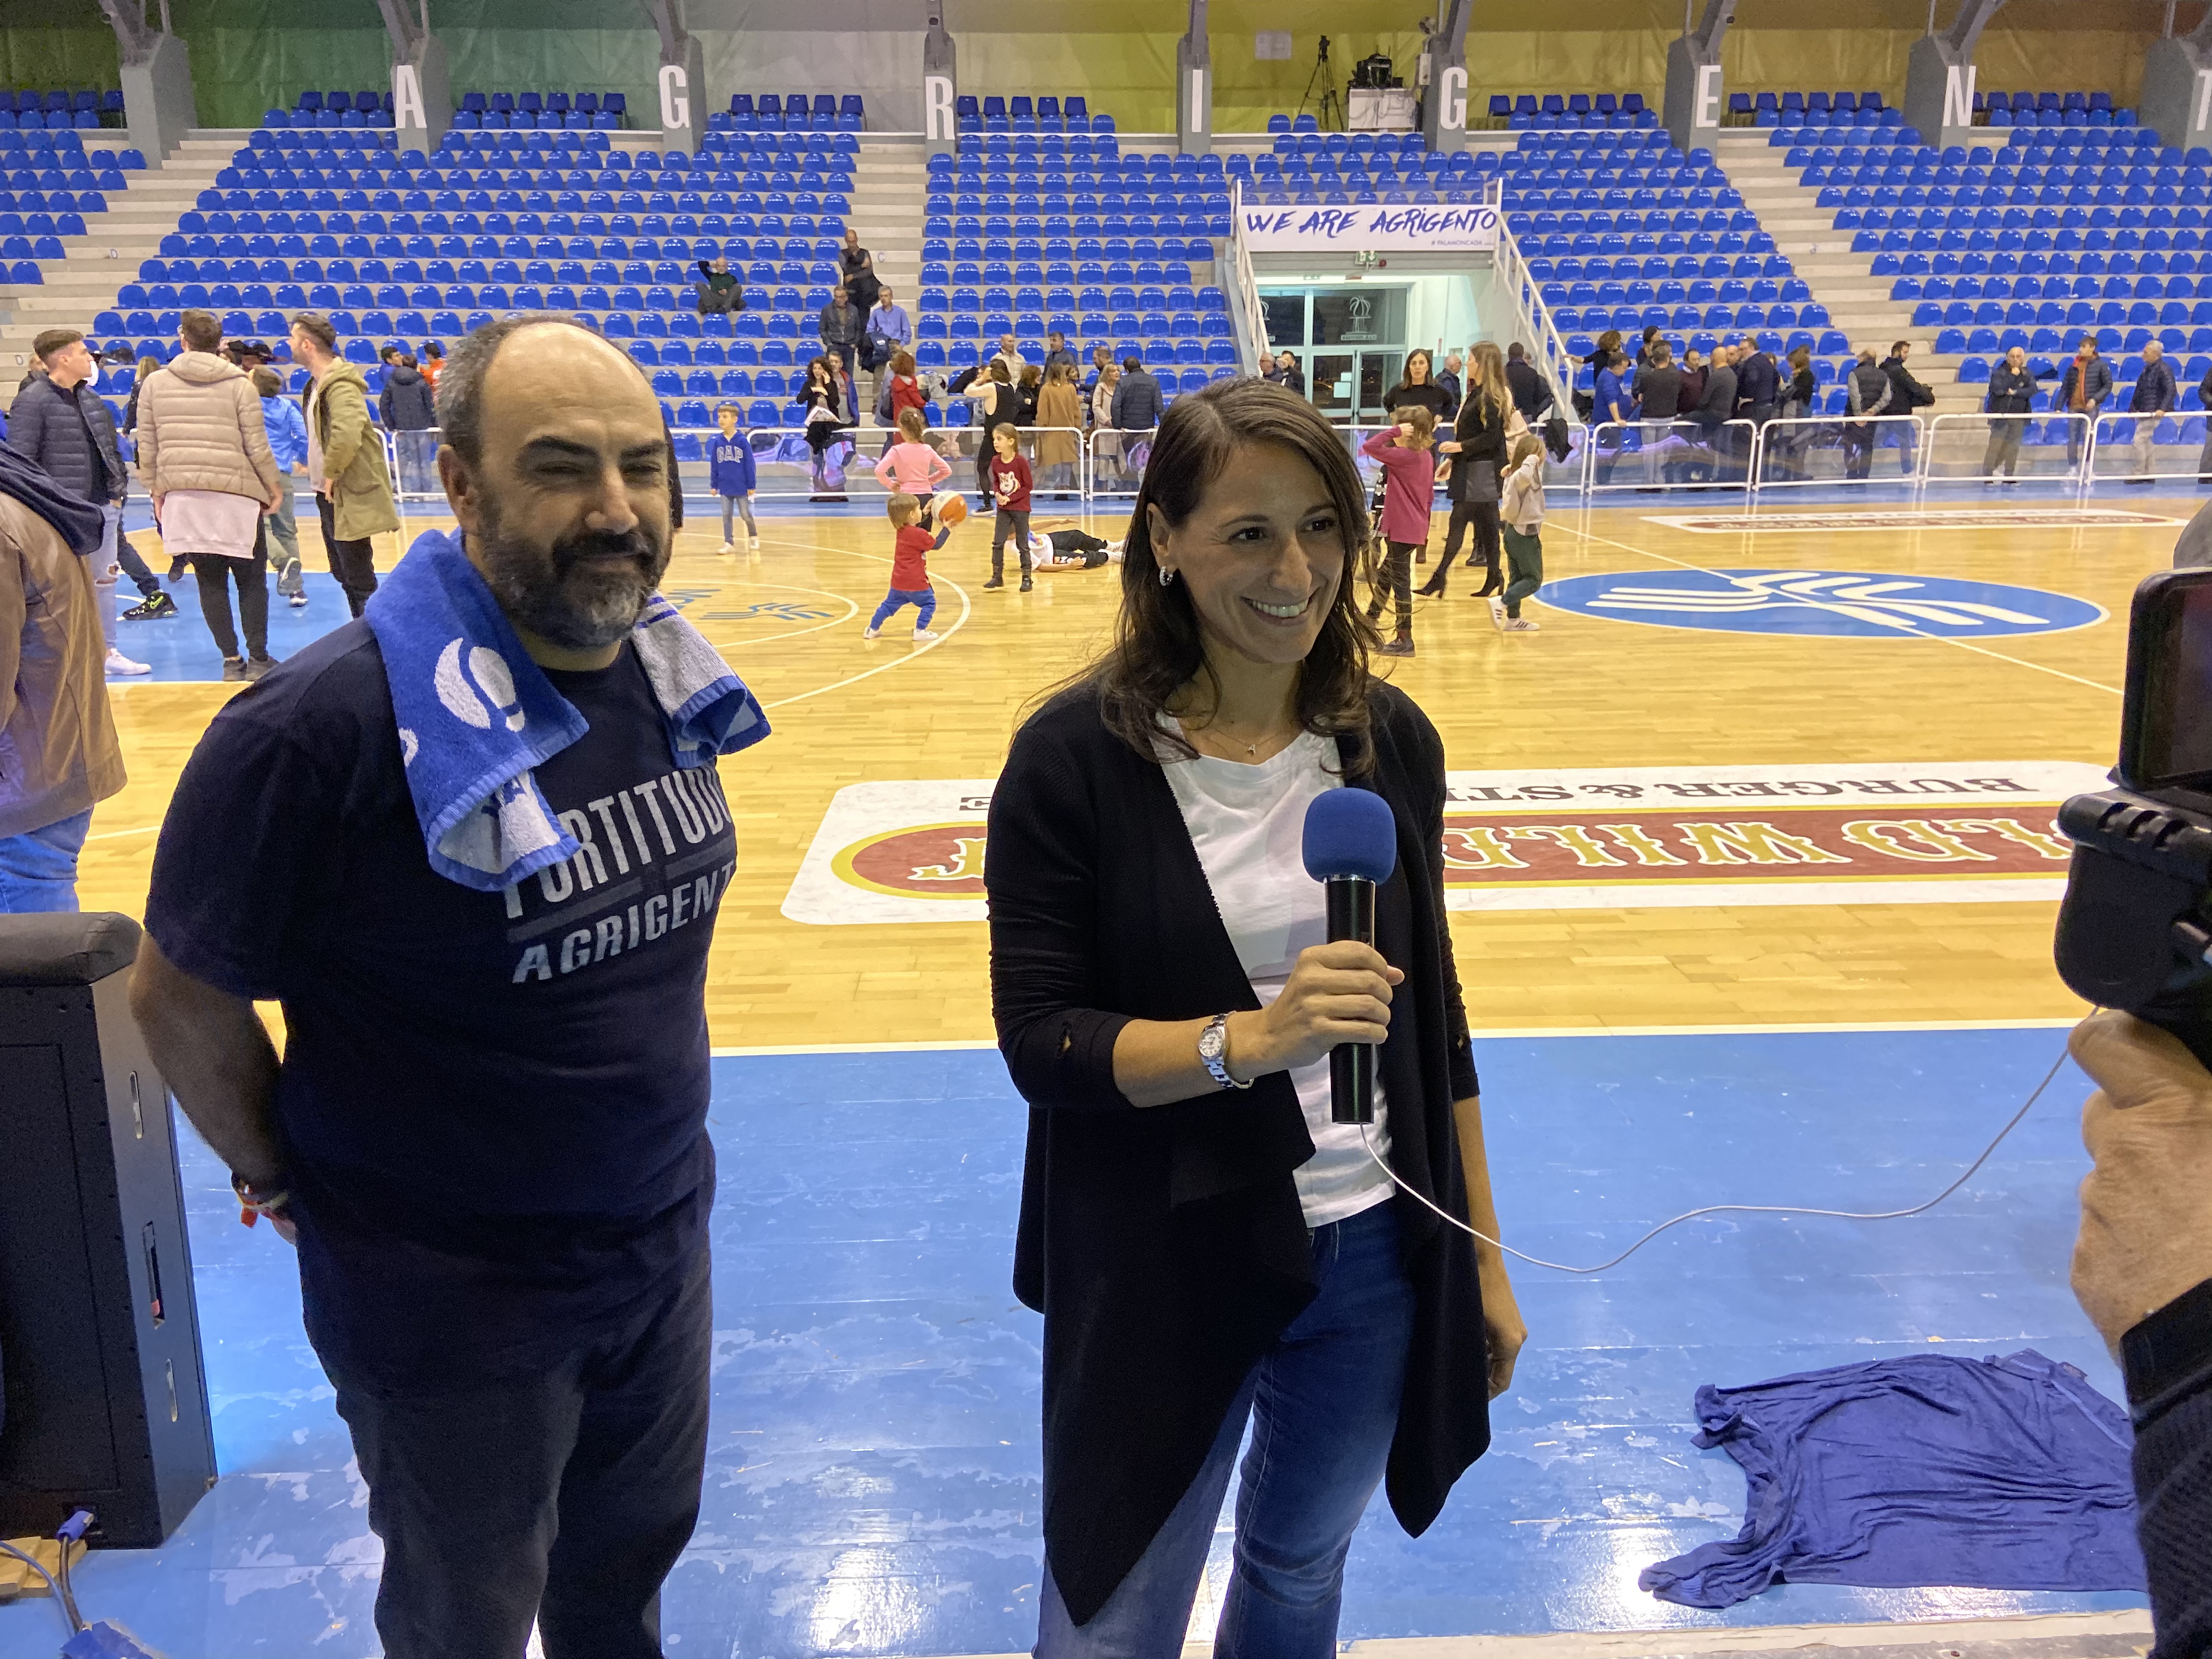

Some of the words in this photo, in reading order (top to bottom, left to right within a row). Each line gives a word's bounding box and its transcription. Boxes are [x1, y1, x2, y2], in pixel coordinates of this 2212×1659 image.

[396, 65, 427, 128] A
[658, 65, 690, 129] G
[926, 76, 955, 140] R
[1192, 69, 1203, 132] I
[1440, 67, 1468, 129] G
[1698, 65, 1721, 127] E
[1943, 65, 1976, 127] N
[1246, 211, 1296, 234] WE
[1299, 208, 1360, 239] ARE
[1578, 784, 1644, 798] &
[1653, 778, 2040, 797] BURGER
[1443, 821, 1853, 868] WILD
[1841, 818, 2072, 862] LD
